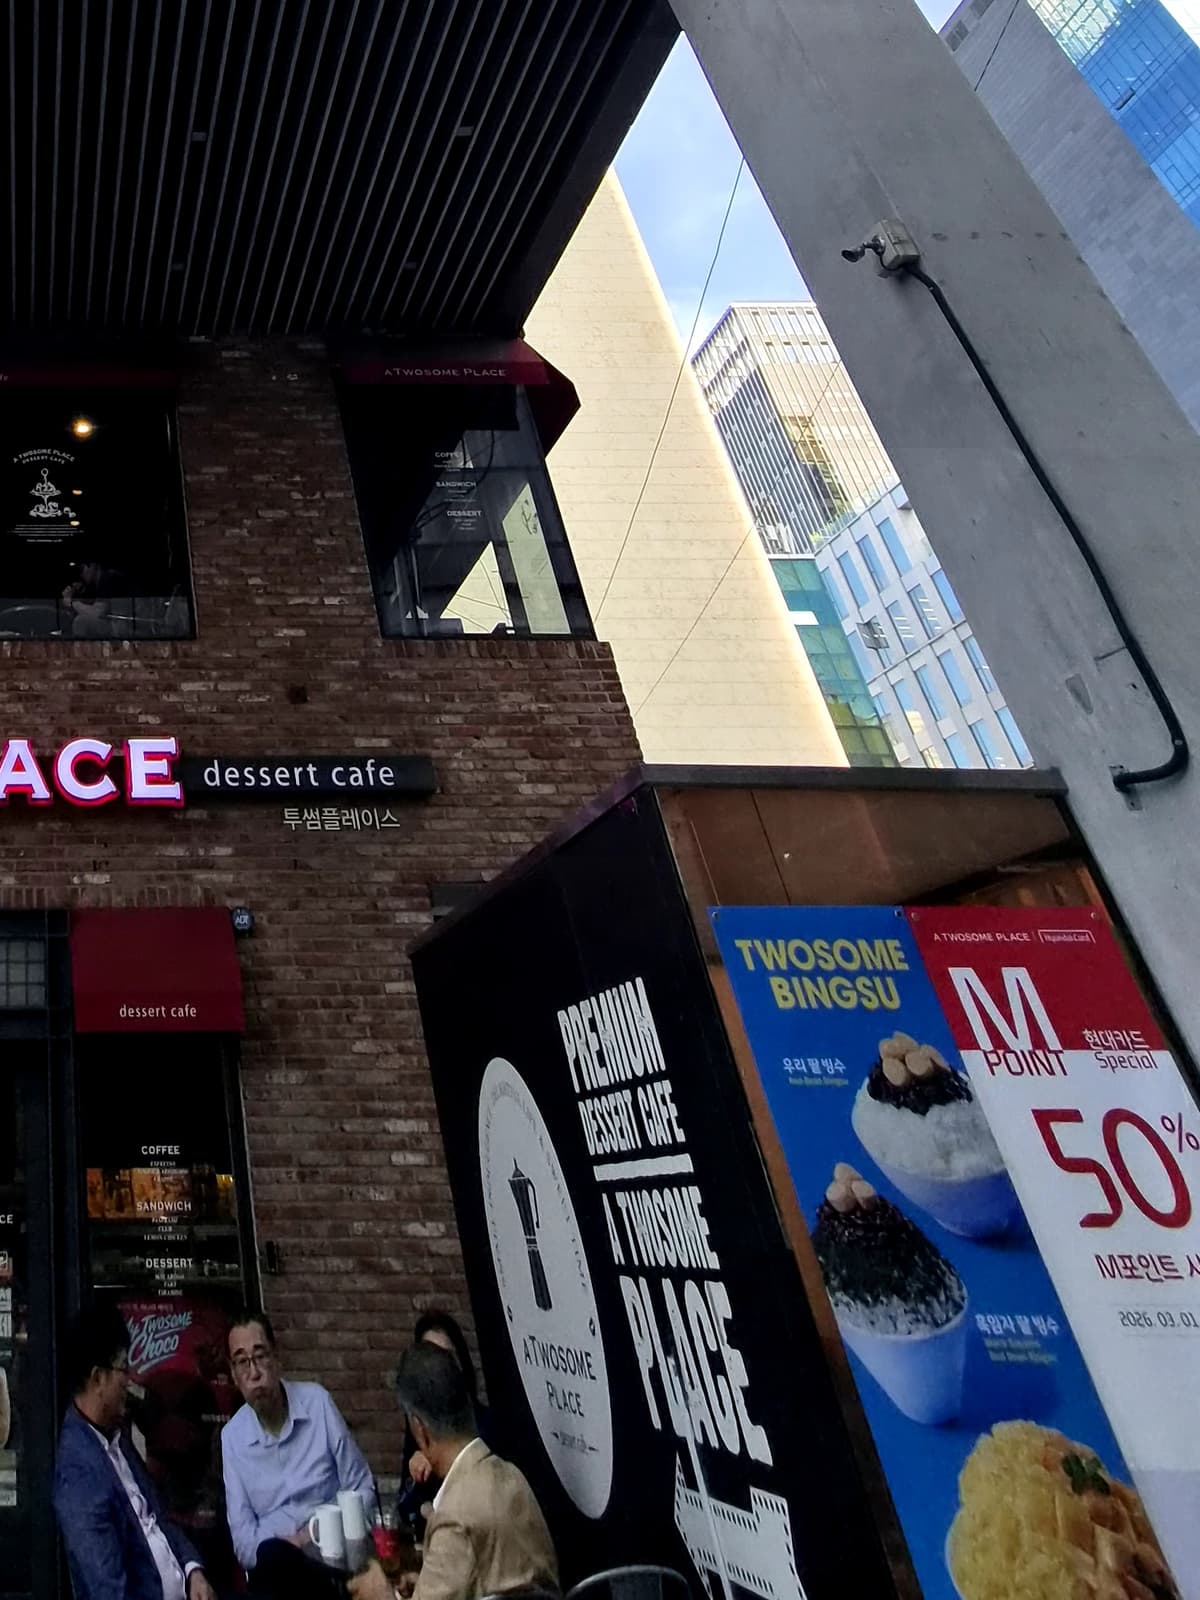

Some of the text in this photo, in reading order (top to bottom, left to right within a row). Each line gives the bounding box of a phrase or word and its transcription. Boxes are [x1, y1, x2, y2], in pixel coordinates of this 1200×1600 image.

[393, 367, 460, 377] TWOSOME
[464, 367, 507, 377] PLACE
[203, 758, 319, 788] dessert
[333, 758, 396, 788] cafe
[282, 807, 401, 832] 투썸플레이스
[942, 932, 994, 943] TWOSOME
[997, 932, 1031, 943] PLACE
[734, 938, 909, 971] TWOSOME
[769, 976, 902, 1011] BINGSU
[947, 966, 1064, 1051] M
[119, 1004, 198, 1018] dessert cafe
[557, 976, 667, 1094] PREMIUM
[1082, 1028, 1151, 1051] 현대카드
[783, 1057, 807, 1074] 우리
[820, 1057, 846, 1075] 빙수
[982, 1048, 1068, 1076] POINT
[1095, 1051, 1158, 1074] Special
[577, 1078, 686, 1157] DESSERT CAFE
[141, 1145, 181, 1156] COFFEE
[1031, 1108, 1200, 1229] 50%
[136, 1201, 192, 1212] SANDWICH
[601, 1184, 720, 1271] A TWOSOME
[145, 1258, 193, 1269] DESSERT
[1094, 1252, 1184, 1283] M포인트
[141, 1311, 193, 1336] TWOSOME
[128, 1333, 179, 1367] Choco
[530, 1334, 597, 1381] TWOSOME
[619, 1274, 773, 1467] PLACE
[547, 1380, 585, 1419] PLACE
